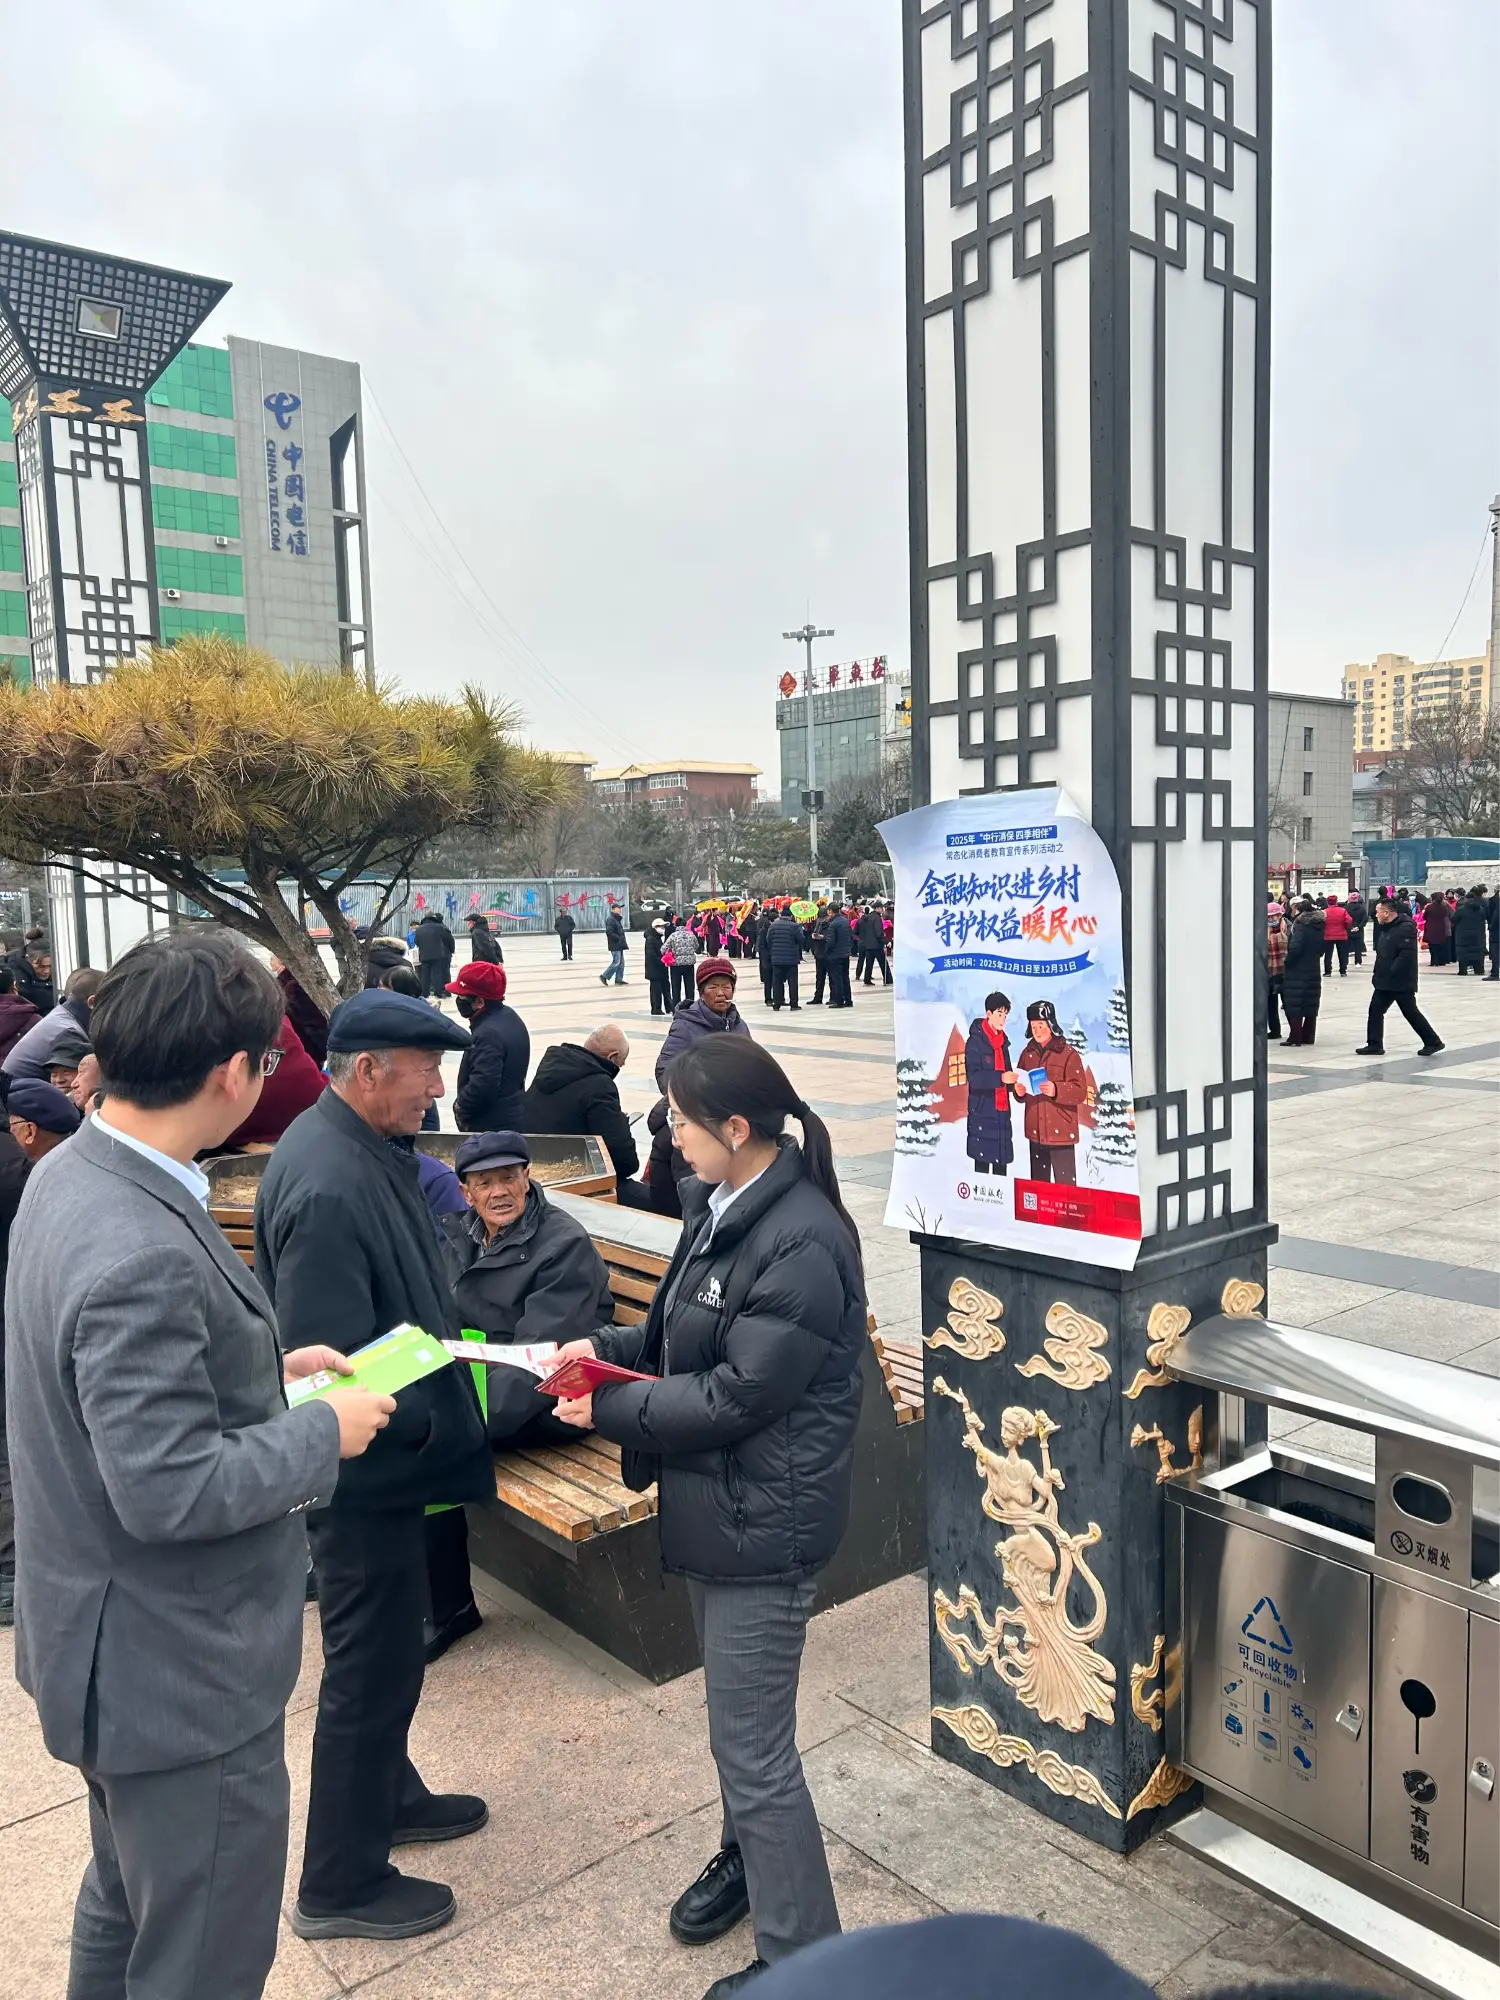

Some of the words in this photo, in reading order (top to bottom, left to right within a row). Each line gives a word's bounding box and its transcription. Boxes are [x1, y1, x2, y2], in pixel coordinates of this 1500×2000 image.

[266, 439, 277, 484] CHINA
[269, 486, 281, 551] TELECOM
[282, 441, 306, 556] 中国电信
[945, 843, 1064, 861] 常态化消费者教育宣传系列活动之
[915, 864, 1082, 908] 金融知识进乡村
[935, 904, 1097, 949] 守护权益暖民心
[1415, 1541, 1451, 1571] 灭烟处
[1238, 1642, 1298, 1681] 可回收物
[1242, 1661, 1292, 1689] Recyclable
[1410, 1804, 1430, 1866] 有害物
